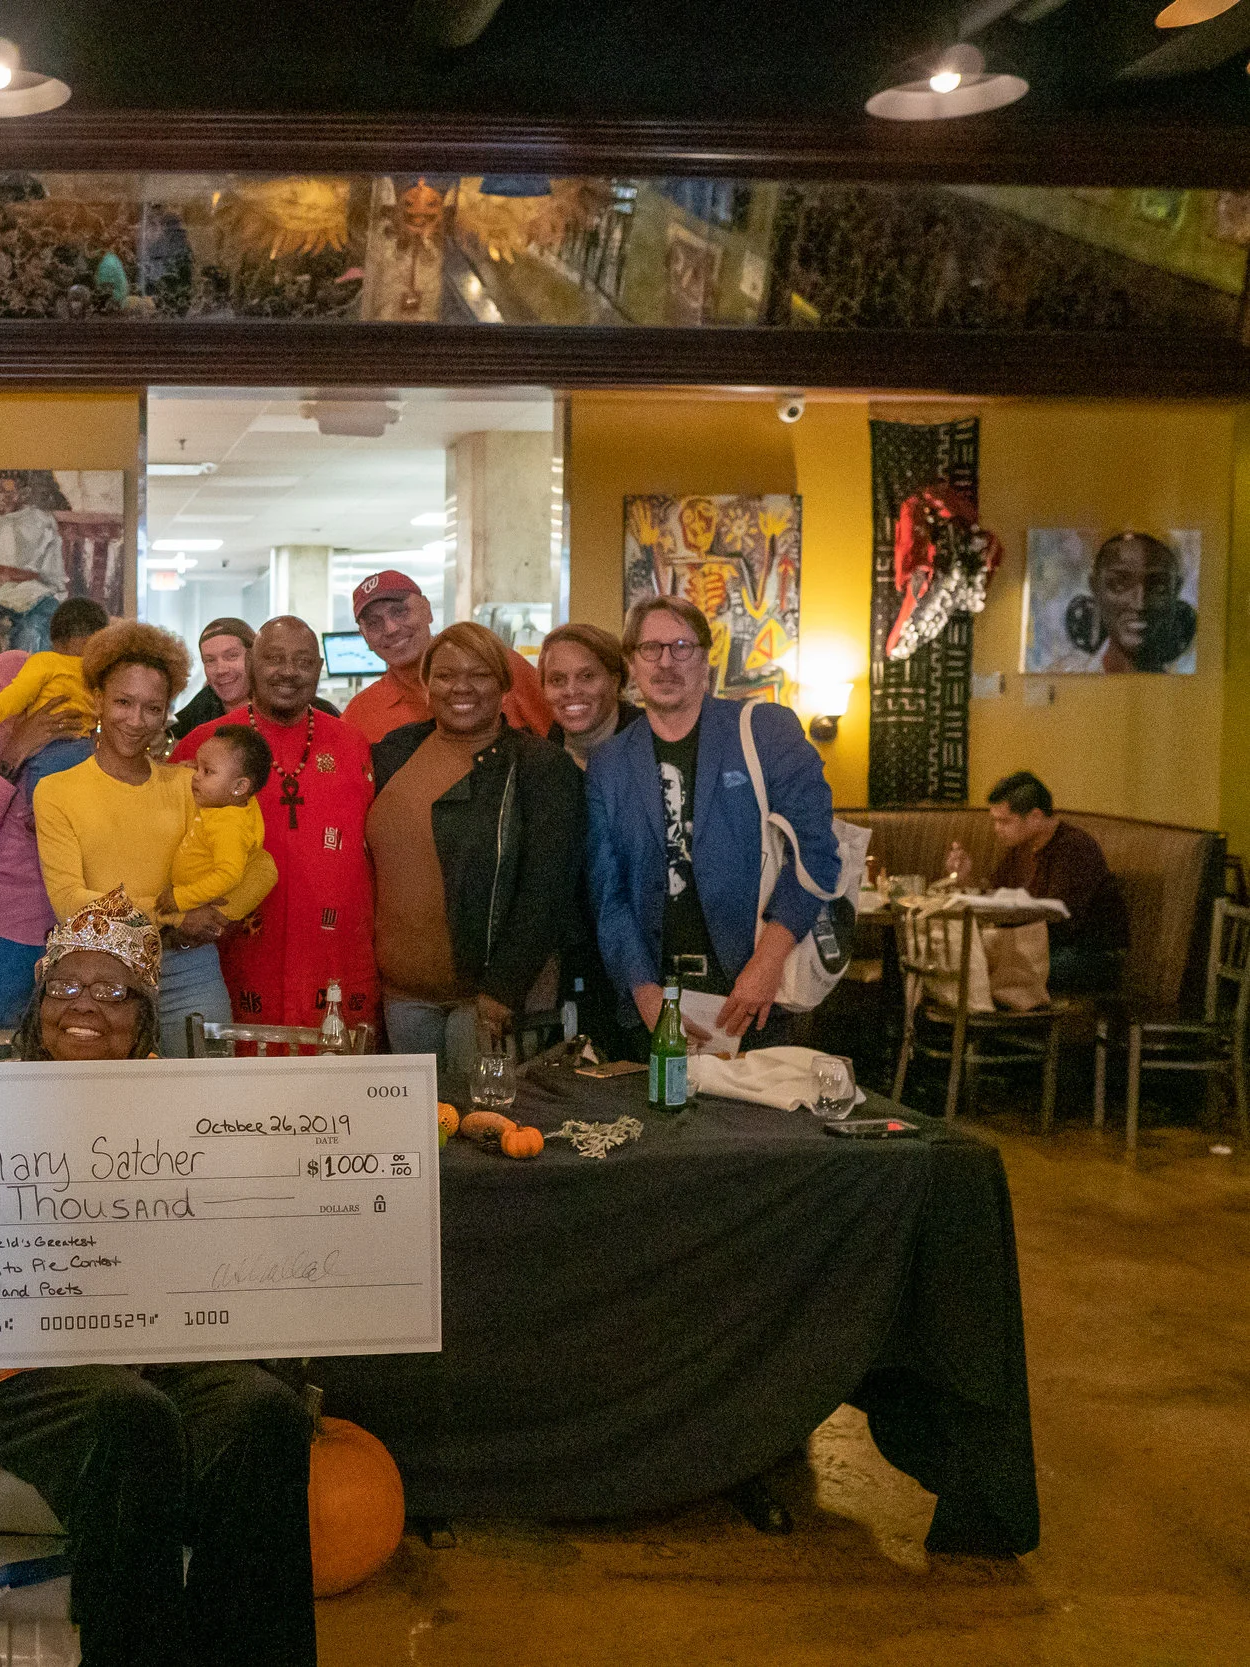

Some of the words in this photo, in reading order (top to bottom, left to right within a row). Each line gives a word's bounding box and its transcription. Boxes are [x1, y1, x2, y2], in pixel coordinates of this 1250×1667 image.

[361, 575, 379, 594] W
[366, 1085, 409, 1098] 0001
[315, 1137, 339, 1145] DATE
[91, 1136, 205, 1179] Satcher
[319, 1204, 360, 1213] DOLLARS
[32, 1258, 69, 1273] Pie
[70, 1255, 122, 1268] Contest
[2, 1284, 30, 1298] and
[39, 1282, 84, 1296] Poets
[184, 1310, 230, 1326] 1000
